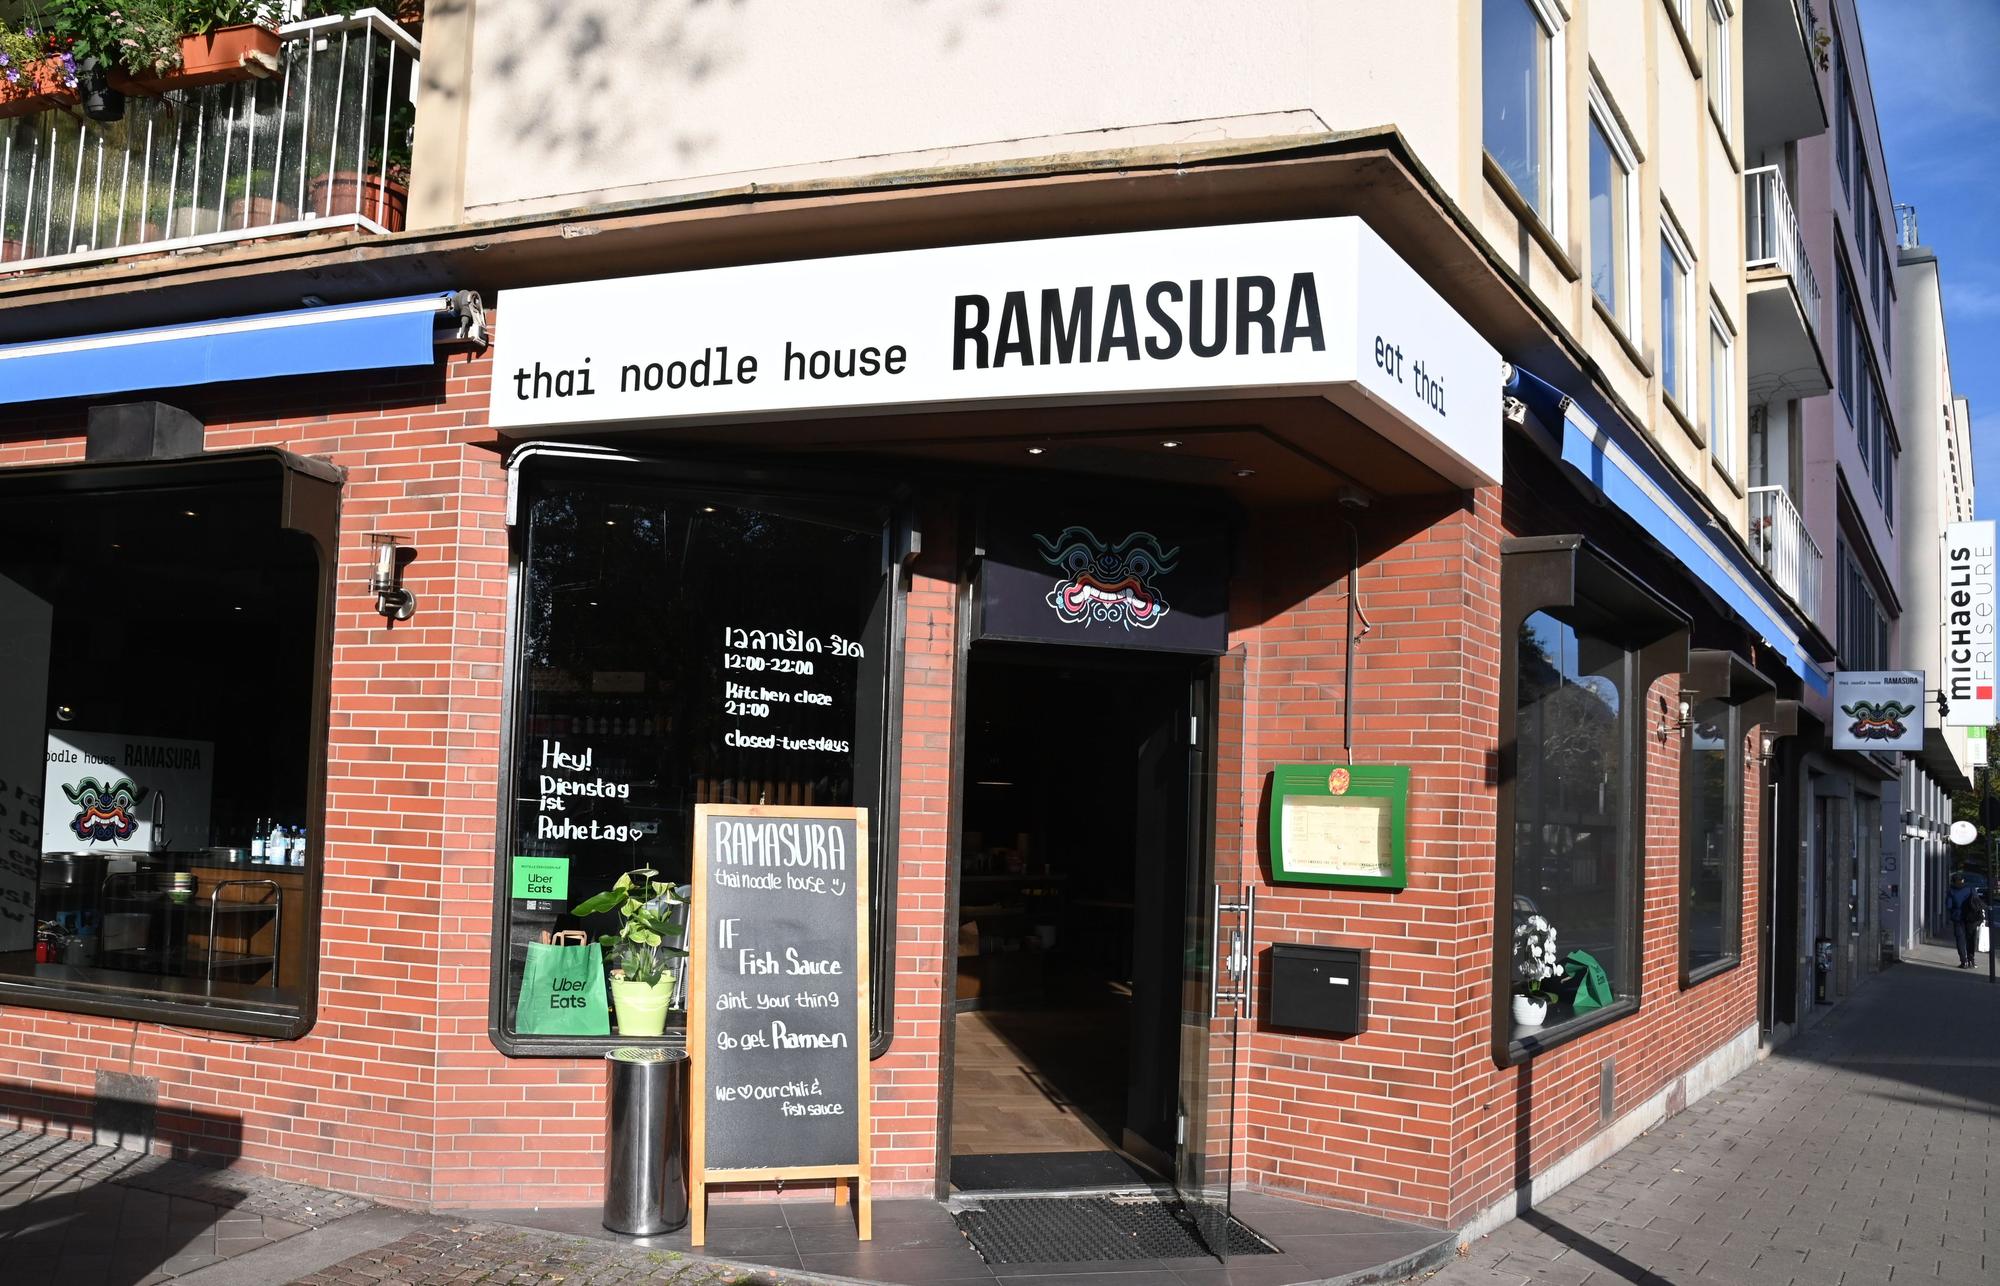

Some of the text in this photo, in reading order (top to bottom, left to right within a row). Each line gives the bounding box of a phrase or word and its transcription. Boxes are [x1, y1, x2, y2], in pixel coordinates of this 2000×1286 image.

[513, 271, 1326, 400] thai noodle house RAMASURA
[1375, 333, 1446, 417] eat thai
[724, 653, 814, 675] 12:00-22:00
[725, 681, 790, 703] Kitchen
[1883, 677, 1919, 685] RAMASURA
[724, 701, 770, 718] 21:00
[46, 743, 201, 770] oodle house RAMASURA
[541, 739, 592, 771] Hey!
[540, 775, 630, 798] Dienstag
[539, 795, 566, 811] ist
[538, 814, 629, 842] Ruhetag
[715, 821, 846, 871] RAMASURA
[527, 883, 553, 894] Eats
[528, 873, 553, 884] Uber
[742, 872, 782, 891] noodle
[786, 871, 827, 894] house
[719, 918, 741, 949] IF
[739, 947, 843, 975] Fish Sauce
[552, 977, 587, 992] Uber
[550, 994, 587, 1009] Eats
[716, 991, 840, 1011] aint your thing
[771, 1020, 848, 1050] Ramen
[780, 1101, 845, 1117] fish sauce
